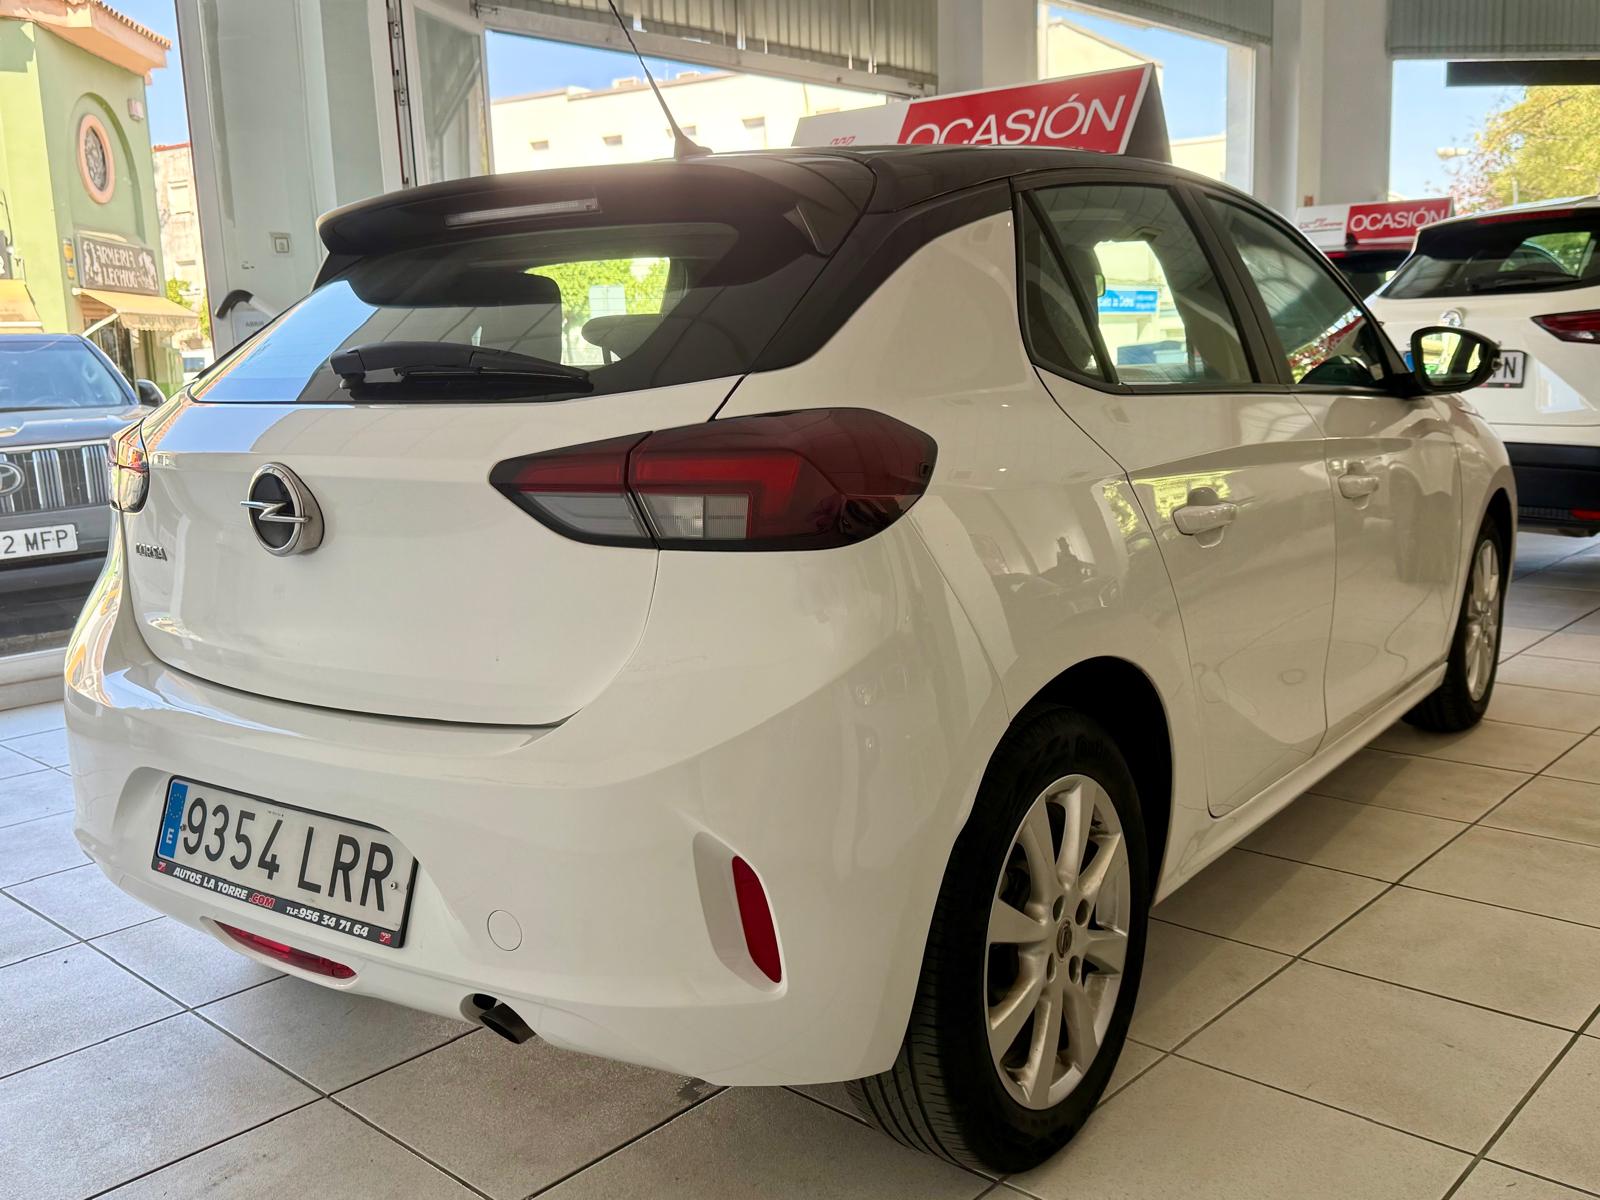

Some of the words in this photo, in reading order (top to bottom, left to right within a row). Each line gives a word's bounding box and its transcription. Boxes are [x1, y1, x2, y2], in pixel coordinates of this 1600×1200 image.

[906, 93, 1126, 145] OCASIÓN
[1351, 207, 1445, 232] OCASIÓN
[24, 529, 68, 552] MFP
[165, 828, 175, 844] E
[183, 797, 283, 880] 9354
[297, 826, 394, 912] LRR
[173, 866, 202, 885] AUTOS
[203, 876, 216, 890] LA
[217, 881, 248, 900] TORRE
[248, 892, 276, 909] .COM
[321, 914, 337, 927] 34
[338, 919, 352, 932] 71
[353, 924, 369, 937] 64
